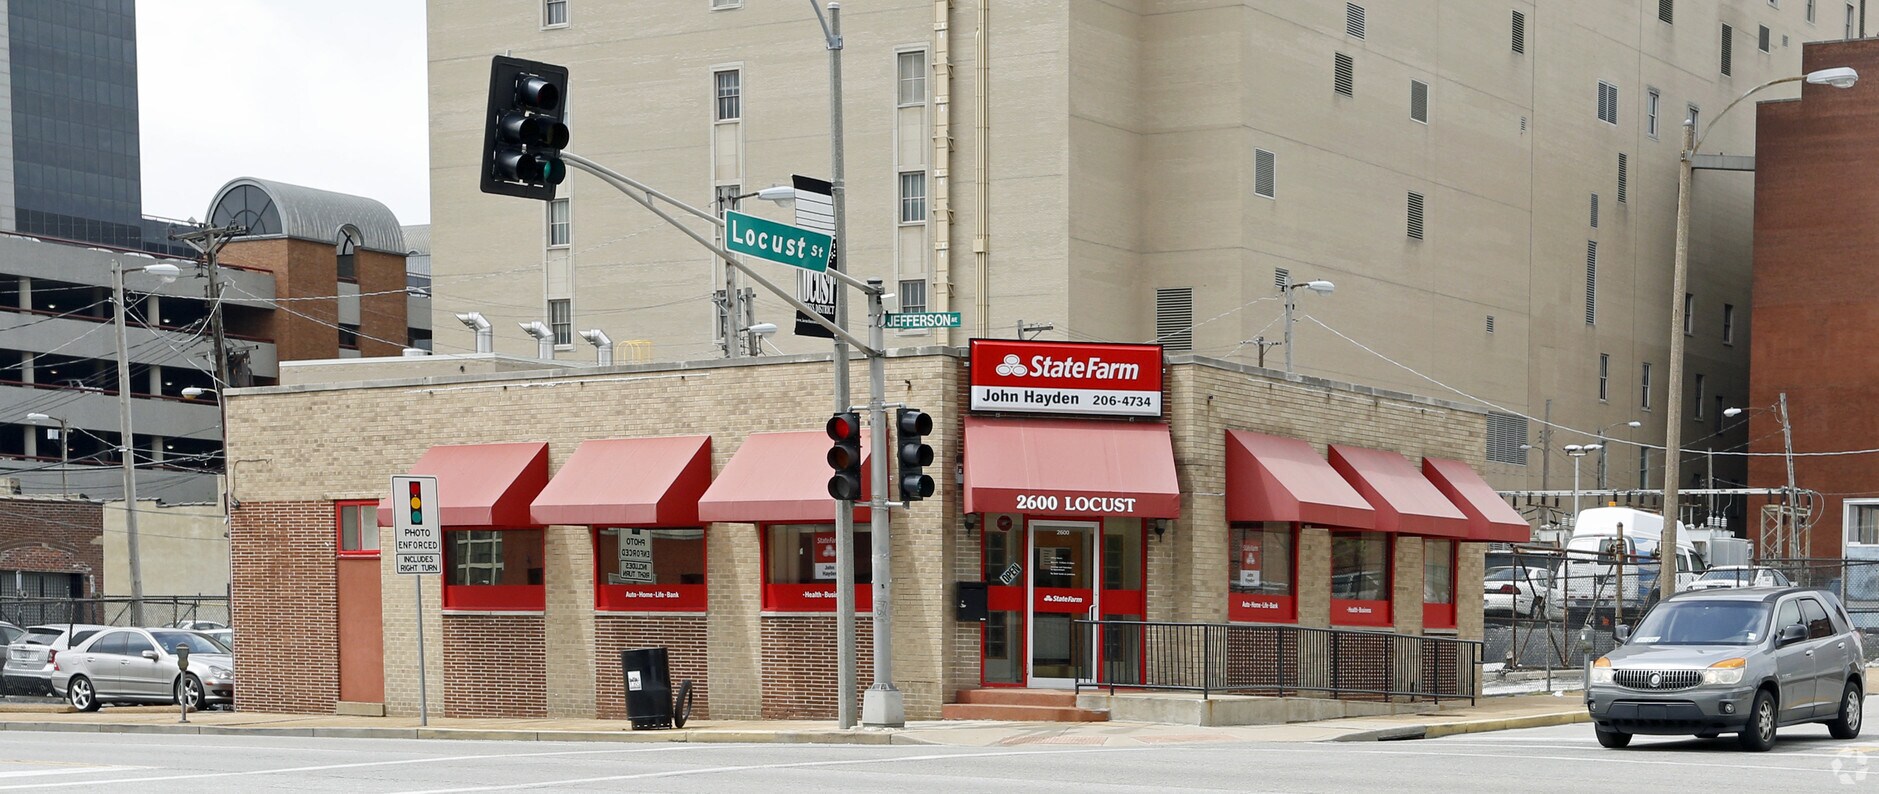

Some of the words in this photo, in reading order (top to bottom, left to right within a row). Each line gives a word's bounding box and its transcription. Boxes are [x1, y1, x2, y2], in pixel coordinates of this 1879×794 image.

[733, 220, 806, 259] Locust
[810, 244, 824, 258] St
[887, 314, 951, 327] JEFFERSON
[982, 389, 1019, 403] John
[1024, 390, 1079, 406] Hayden
[1093, 395, 1152, 407] 206-4734
[1016, 495, 1058, 510] 2600
[1065, 496, 1136, 513] LOCUST
[404, 528, 431, 537] PHOTO
[398, 541, 438, 549] ENFORCED
[403, 555, 434, 563] INCLUDES
[400, 564, 418, 572] RIGHT
[421, 564, 438, 572] TURN
[1001, 563, 1021, 583] OPEN
